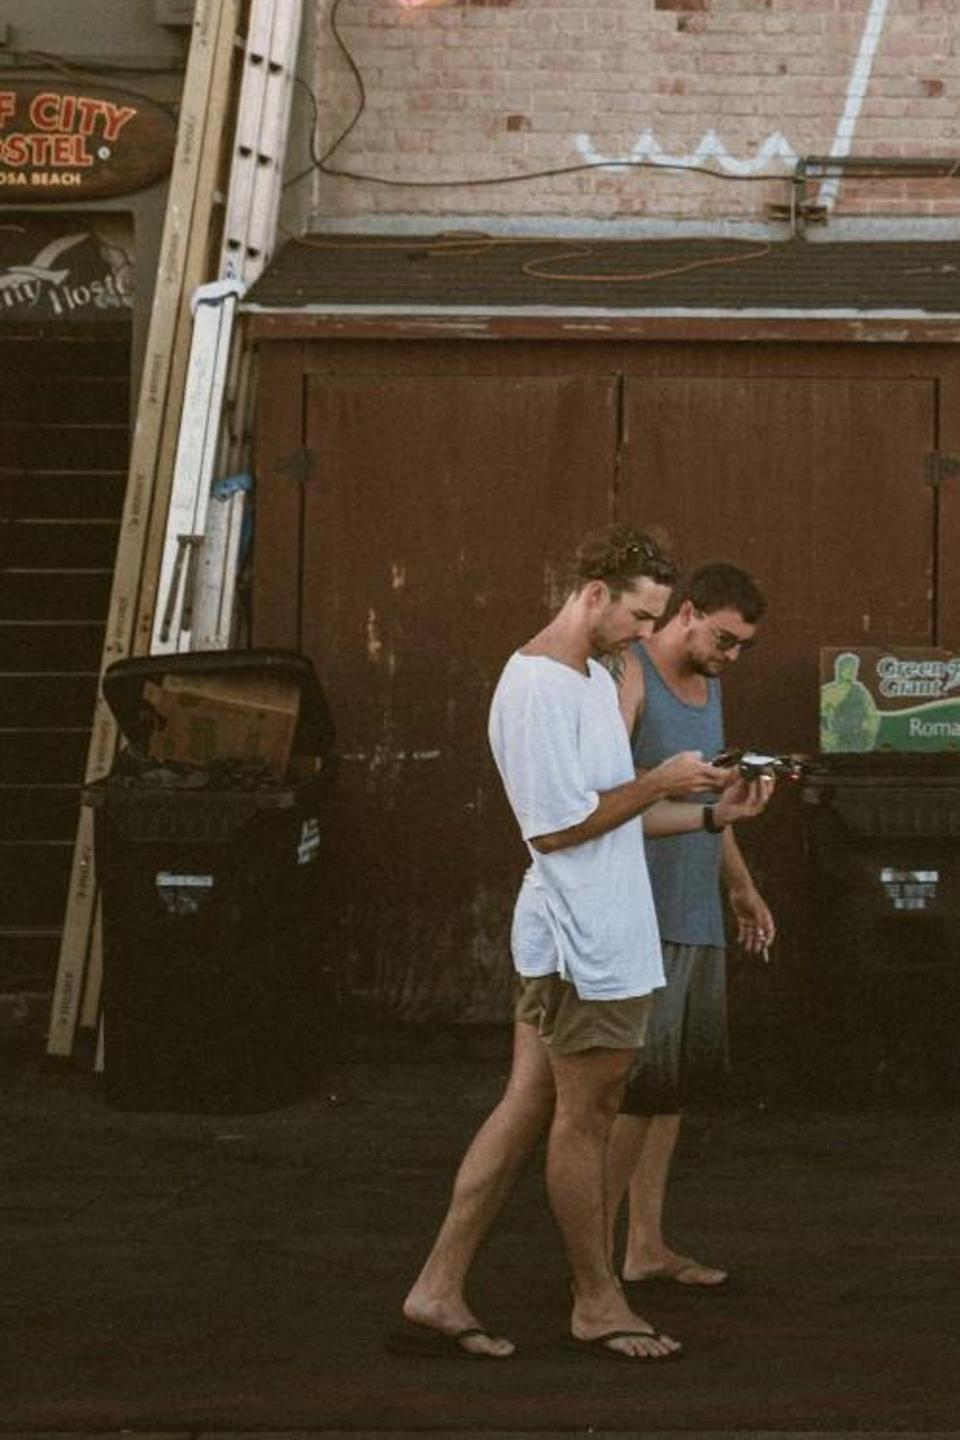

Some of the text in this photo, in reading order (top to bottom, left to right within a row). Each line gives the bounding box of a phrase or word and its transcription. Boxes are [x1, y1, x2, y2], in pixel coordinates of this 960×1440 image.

[30, 93, 138, 141] CITY
[0, 132, 94, 167] STEL
[31, 172, 82, 186] BEACH
[877, 656, 947, 679] Green
